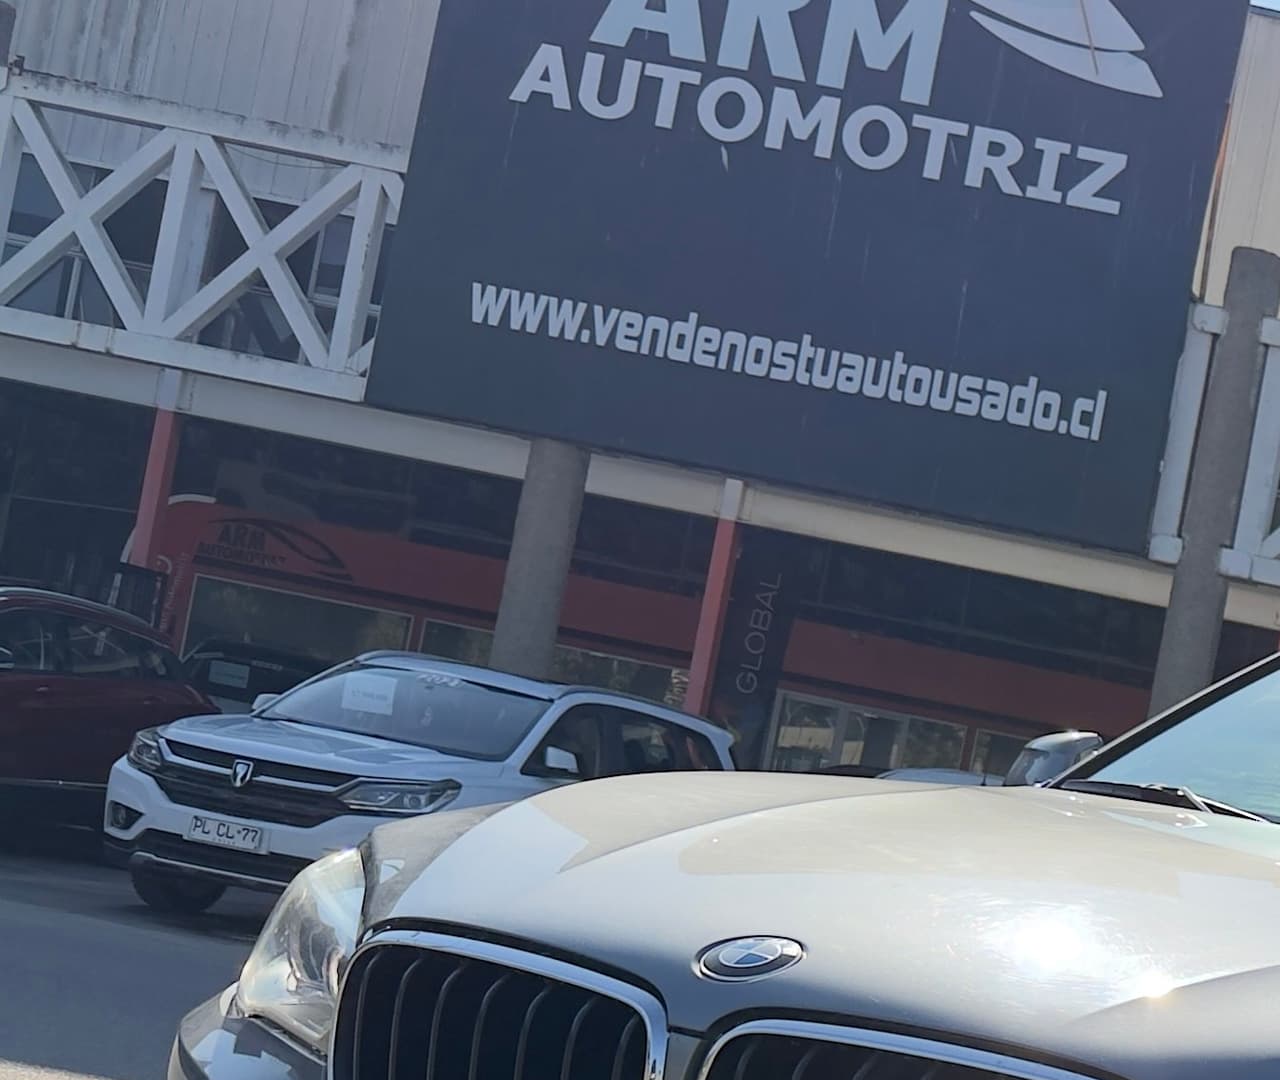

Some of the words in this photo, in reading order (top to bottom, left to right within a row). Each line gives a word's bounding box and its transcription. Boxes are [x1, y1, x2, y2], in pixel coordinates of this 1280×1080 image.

[508, 43, 1129, 216] AUTOMOTRIZ
[469, 281, 1109, 442] www.vendenostuautousado.cl
[736, 573, 783, 695] GLOBAL
